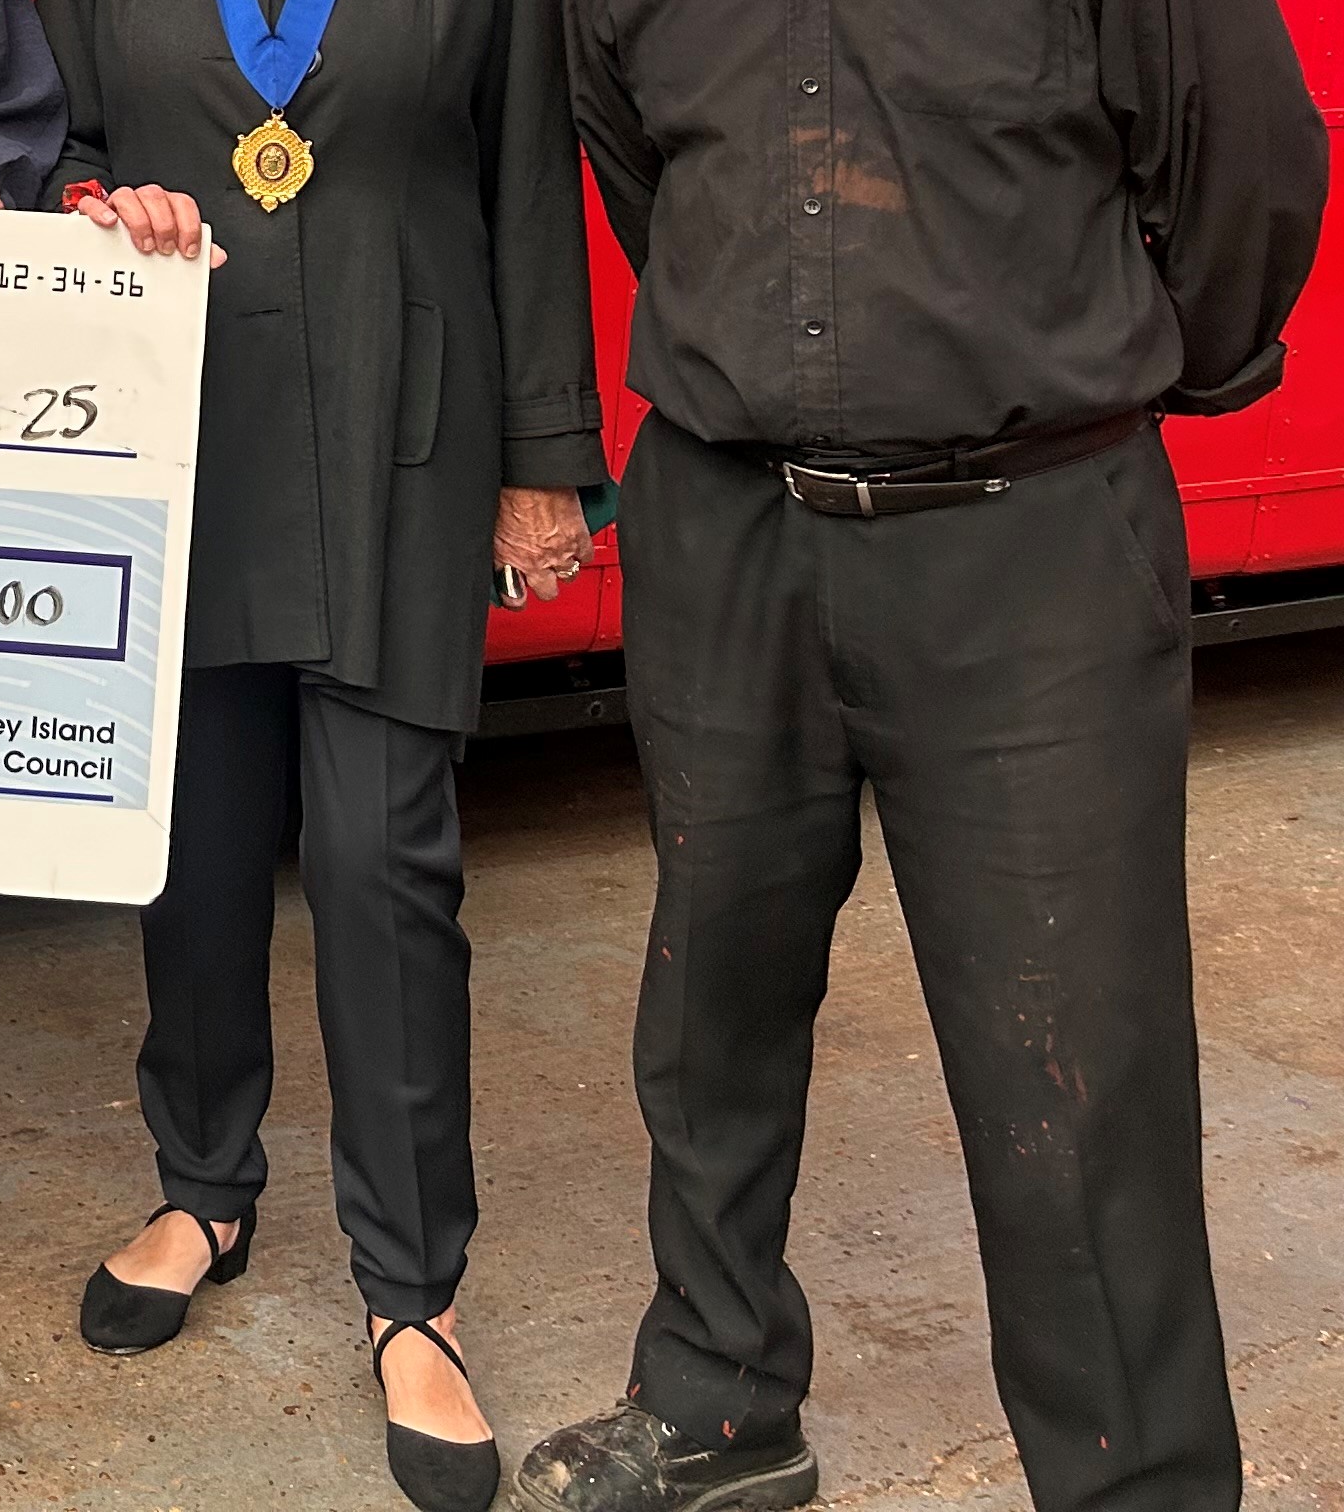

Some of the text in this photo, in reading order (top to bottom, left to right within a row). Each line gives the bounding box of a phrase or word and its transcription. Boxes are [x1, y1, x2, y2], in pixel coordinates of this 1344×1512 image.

[21, 383, 99, 441] 25
[31, 716, 116, 745] Island
[3, 750, 114, 781] Council
